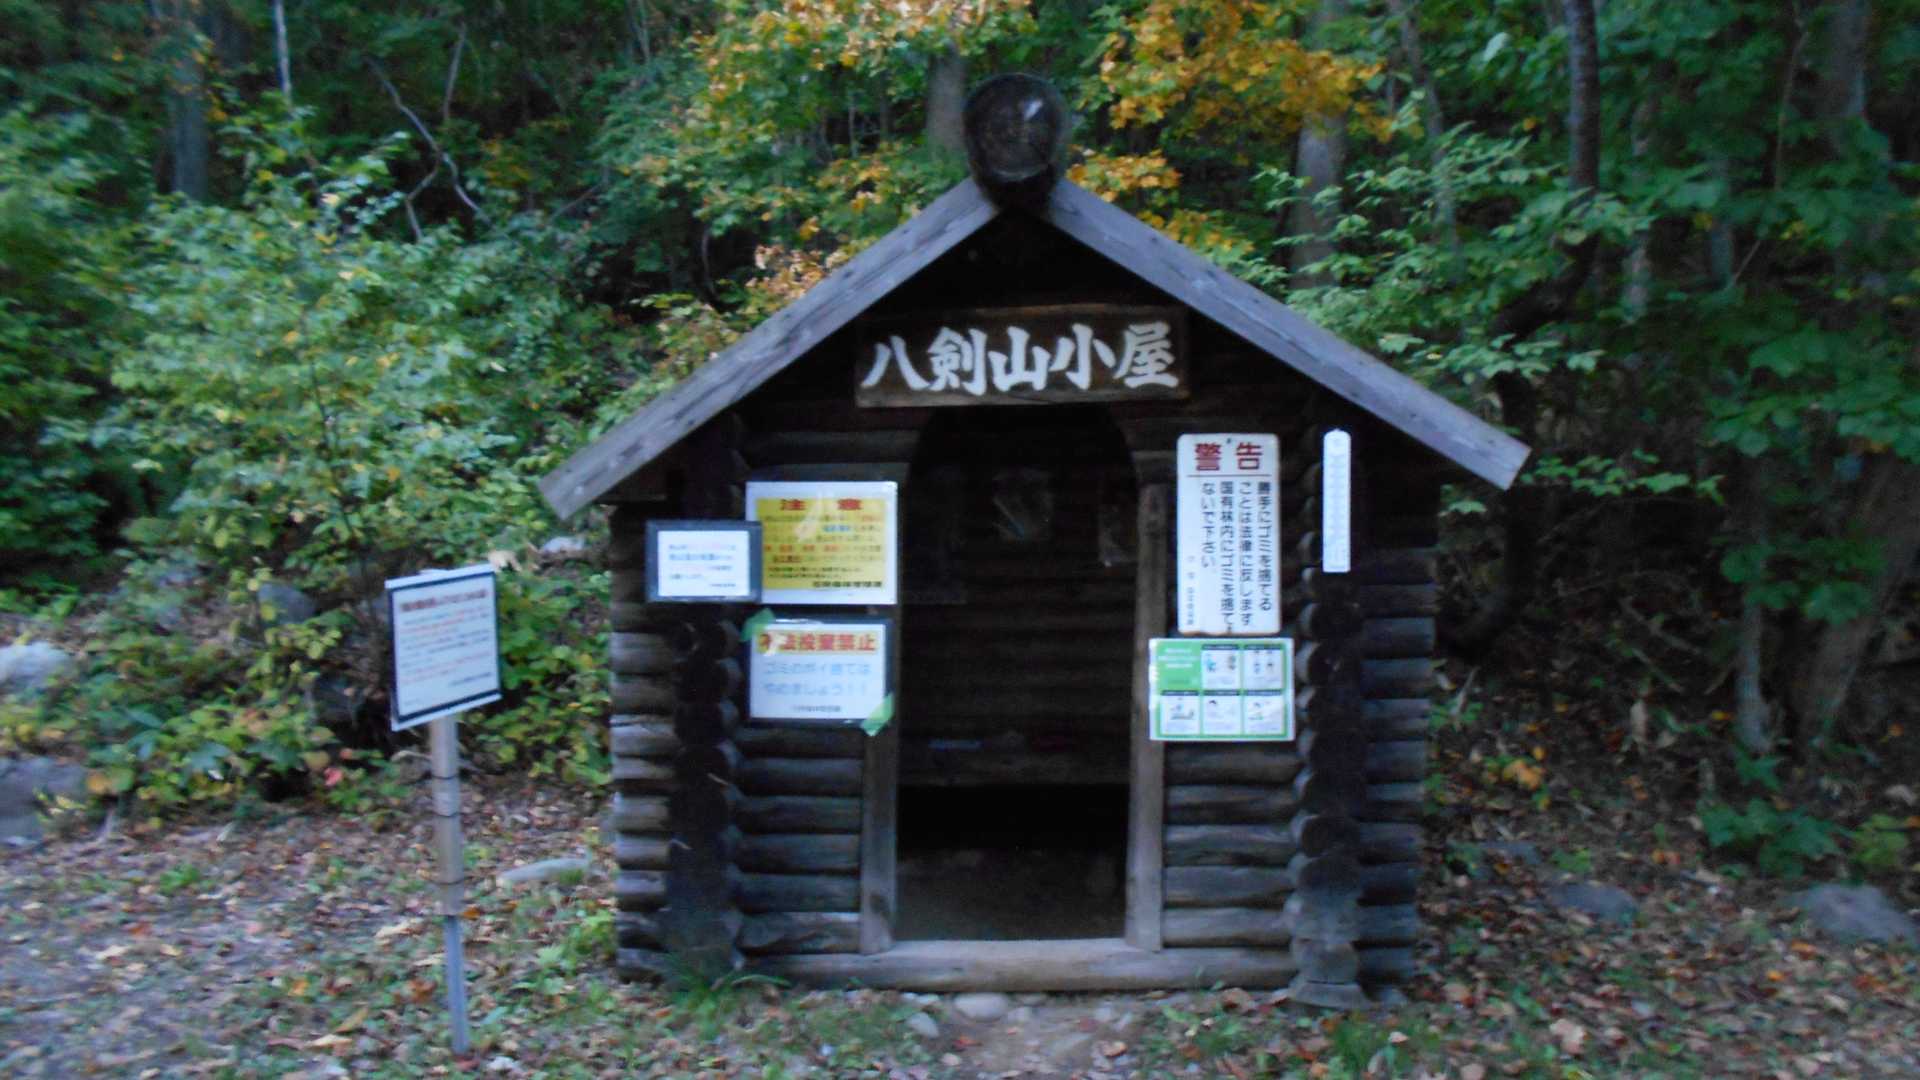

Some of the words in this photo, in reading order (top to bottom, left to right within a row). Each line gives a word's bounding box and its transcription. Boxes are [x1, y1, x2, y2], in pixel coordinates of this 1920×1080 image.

[861, 322, 1179, 397] 八剣山小屋
[1195, 441, 1263, 471] 警告
[1201, 482, 1216, 569] ないで下さい
